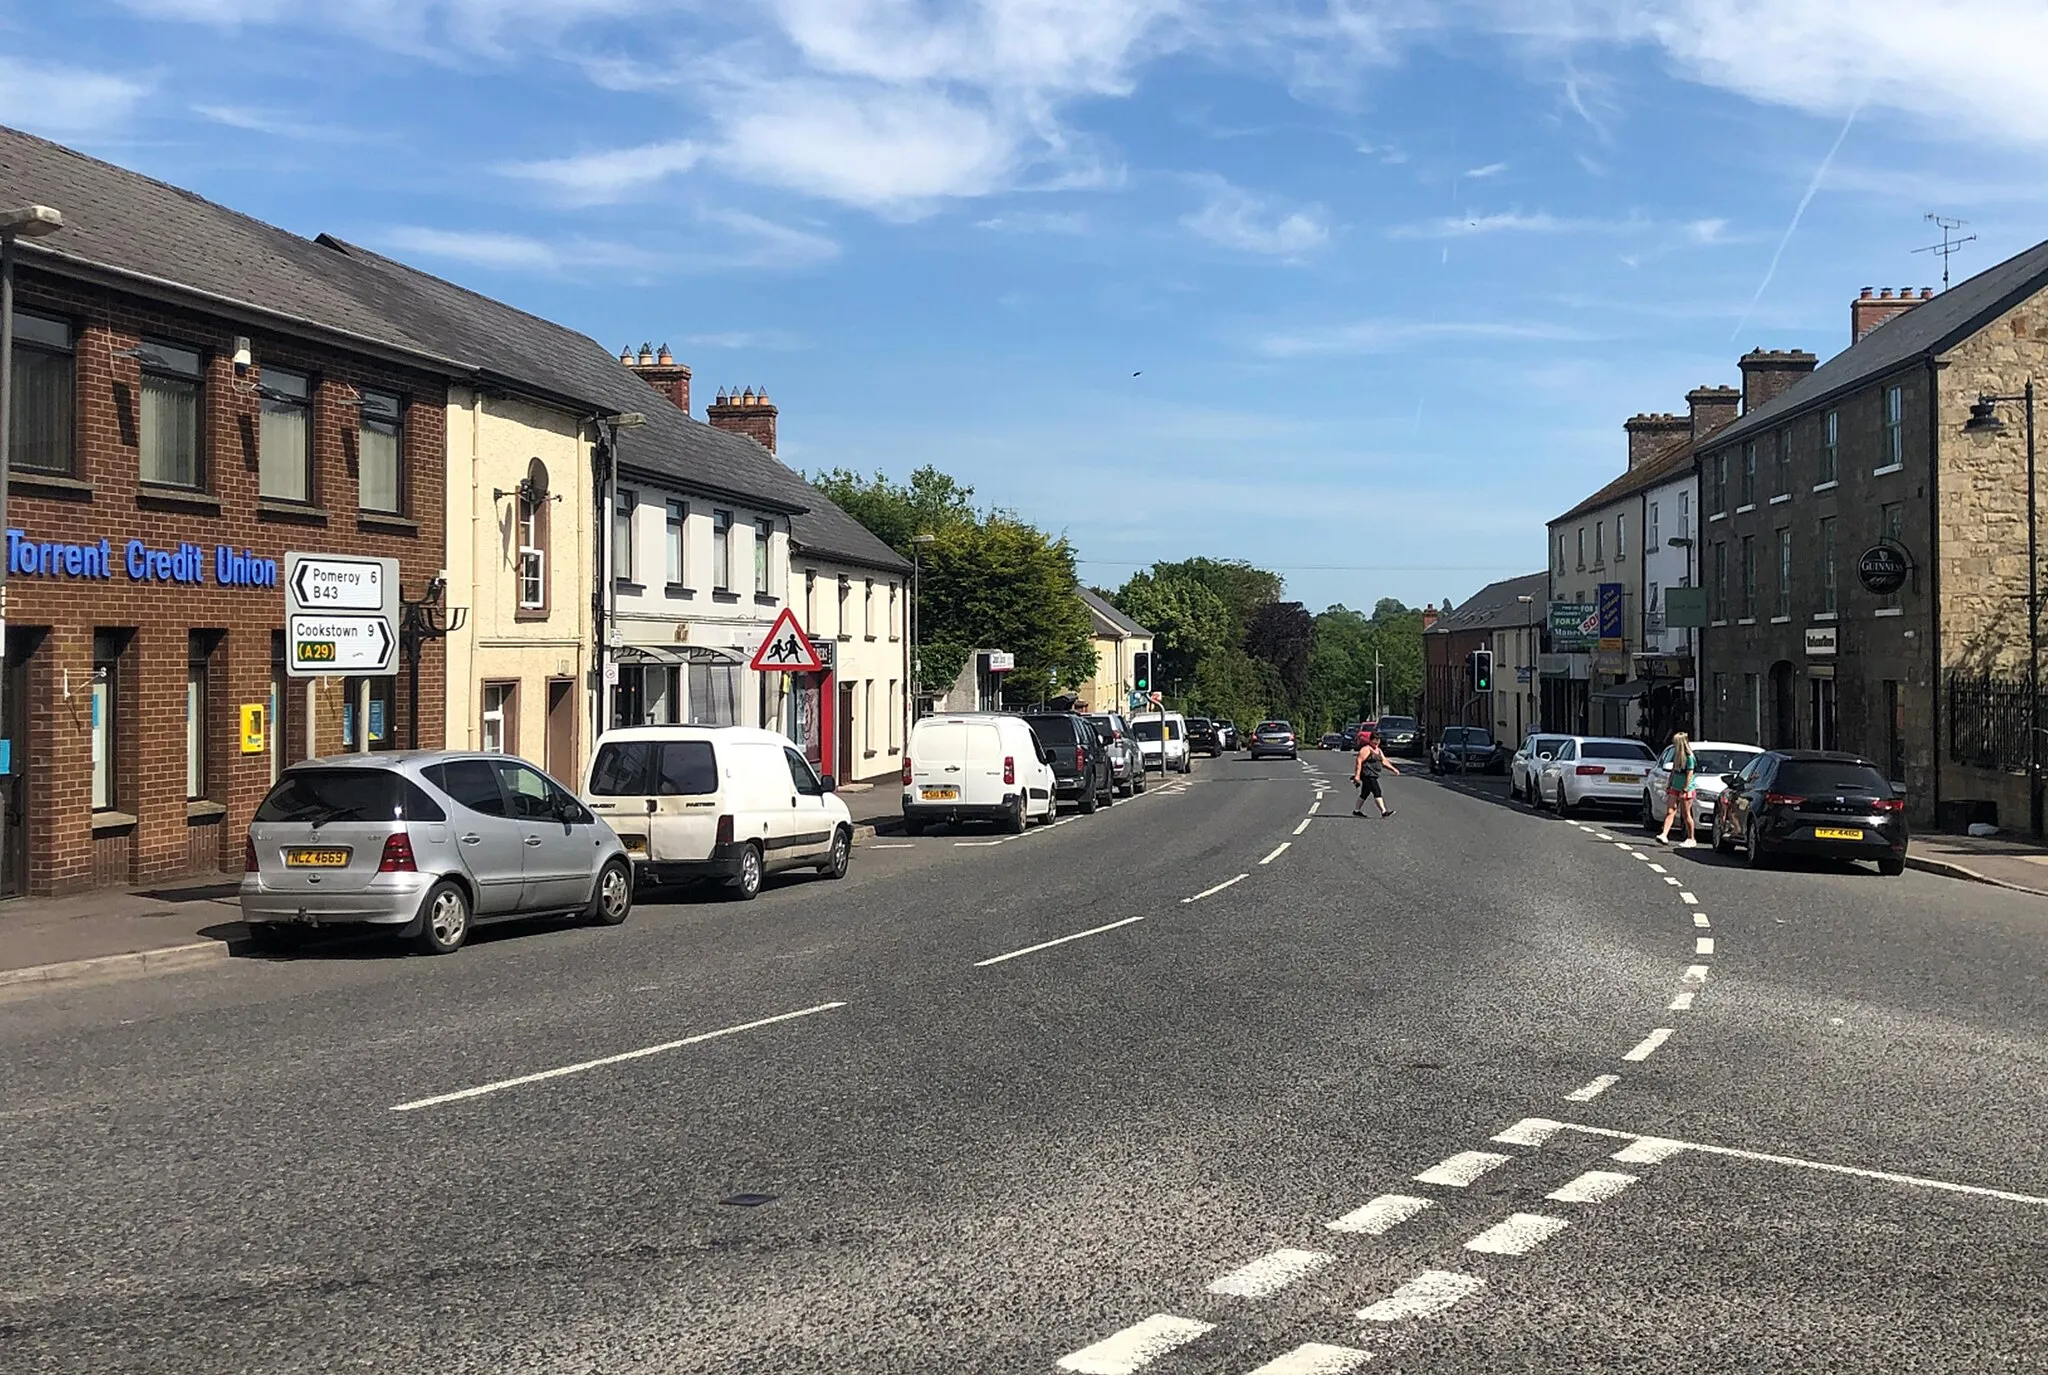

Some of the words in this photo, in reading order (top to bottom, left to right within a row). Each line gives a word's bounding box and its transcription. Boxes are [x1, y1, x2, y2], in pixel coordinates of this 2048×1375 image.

[7, 528, 111, 579] Torrent
[126, 539, 204, 585] Credit
[216, 544, 277, 588] Union
[1862, 560, 1904, 572] GUINNESS
[313, 568, 361, 586] Pomeroy
[370, 571, 378, 584] 6
[313, 586, 339, 600] B43
[296, 623, 358, 637] Cookstown
[367, 624, 375, 637] 9
[298, 643, 335, 660] (A29)
[291, 851, 313, 863] NLZ
[314, 851, 343, 863] 4669
